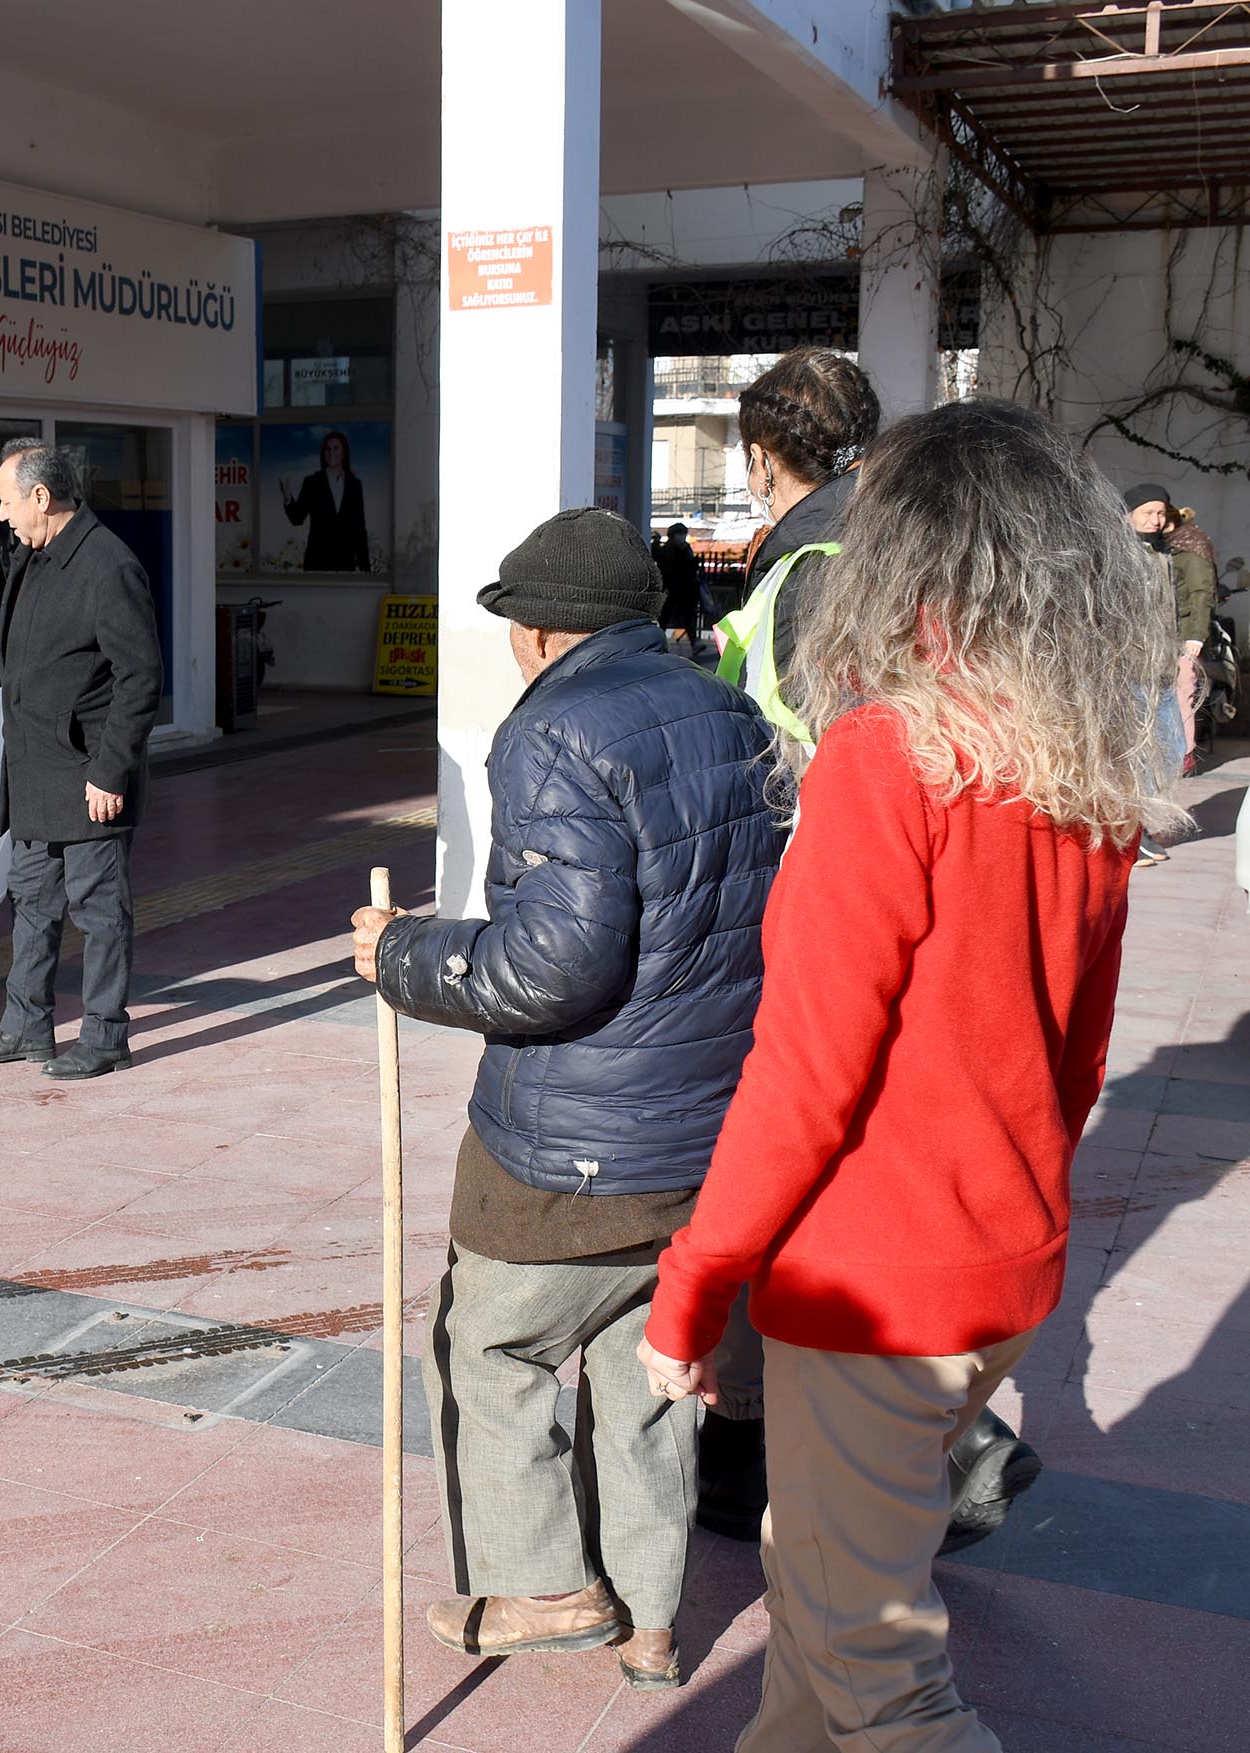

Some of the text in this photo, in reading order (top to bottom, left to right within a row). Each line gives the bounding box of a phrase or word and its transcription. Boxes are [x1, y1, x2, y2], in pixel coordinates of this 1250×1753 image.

[12, 218, 97, 253] BELEDİYESİ
[516, 231, 533, 246] ÇAY
[74, 264, 234, 331] MÜDÜRLÜĞÜ
[742, 310, 847, 331] GENEL
